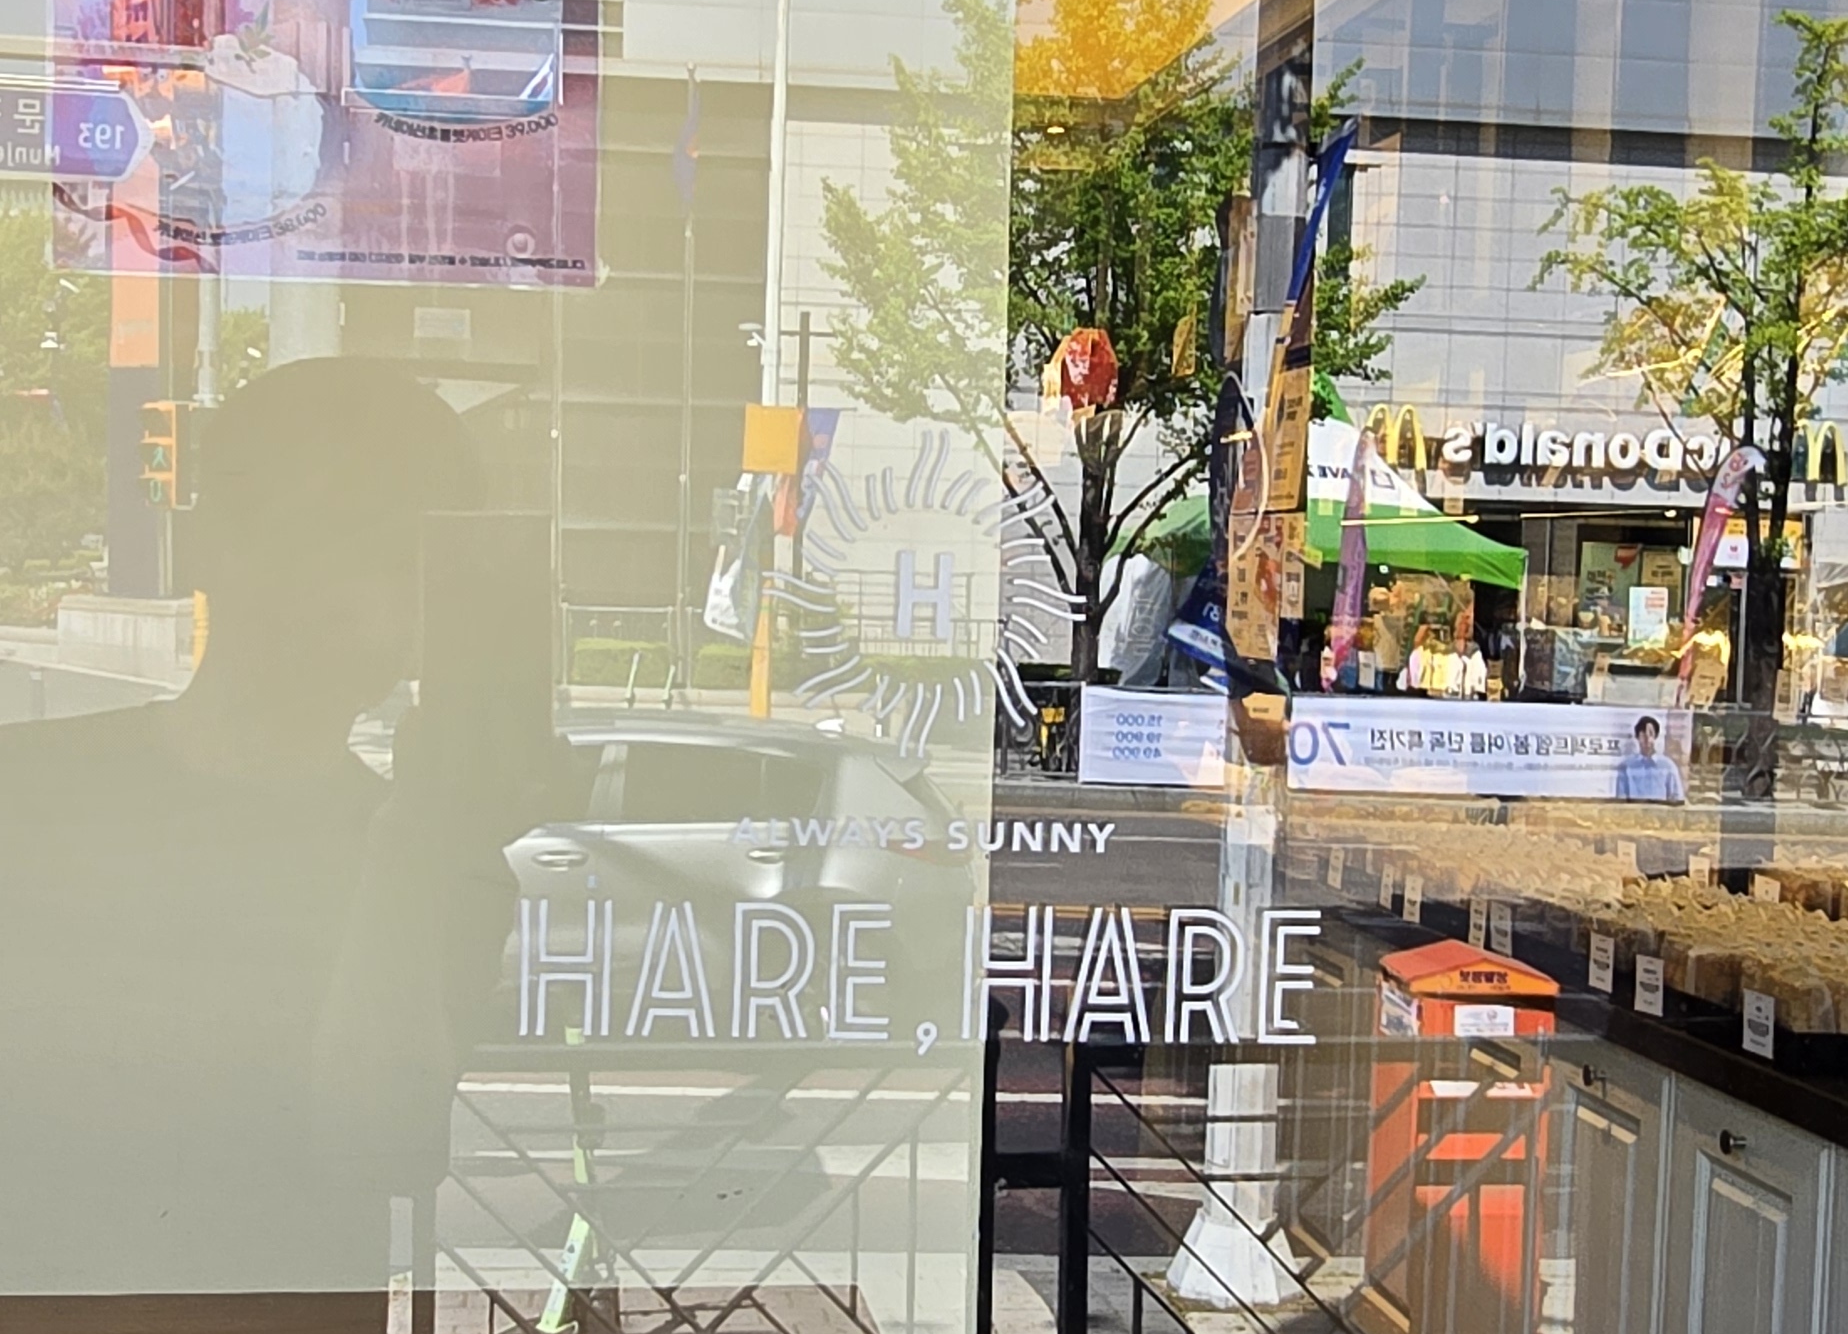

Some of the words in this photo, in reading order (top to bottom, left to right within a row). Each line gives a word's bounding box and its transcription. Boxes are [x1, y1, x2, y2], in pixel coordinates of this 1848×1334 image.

[896, 549, 955, 642] H
[733, 816, 926, 852] ALWAYS
[947, 820, 1116, 855] SUNNY
